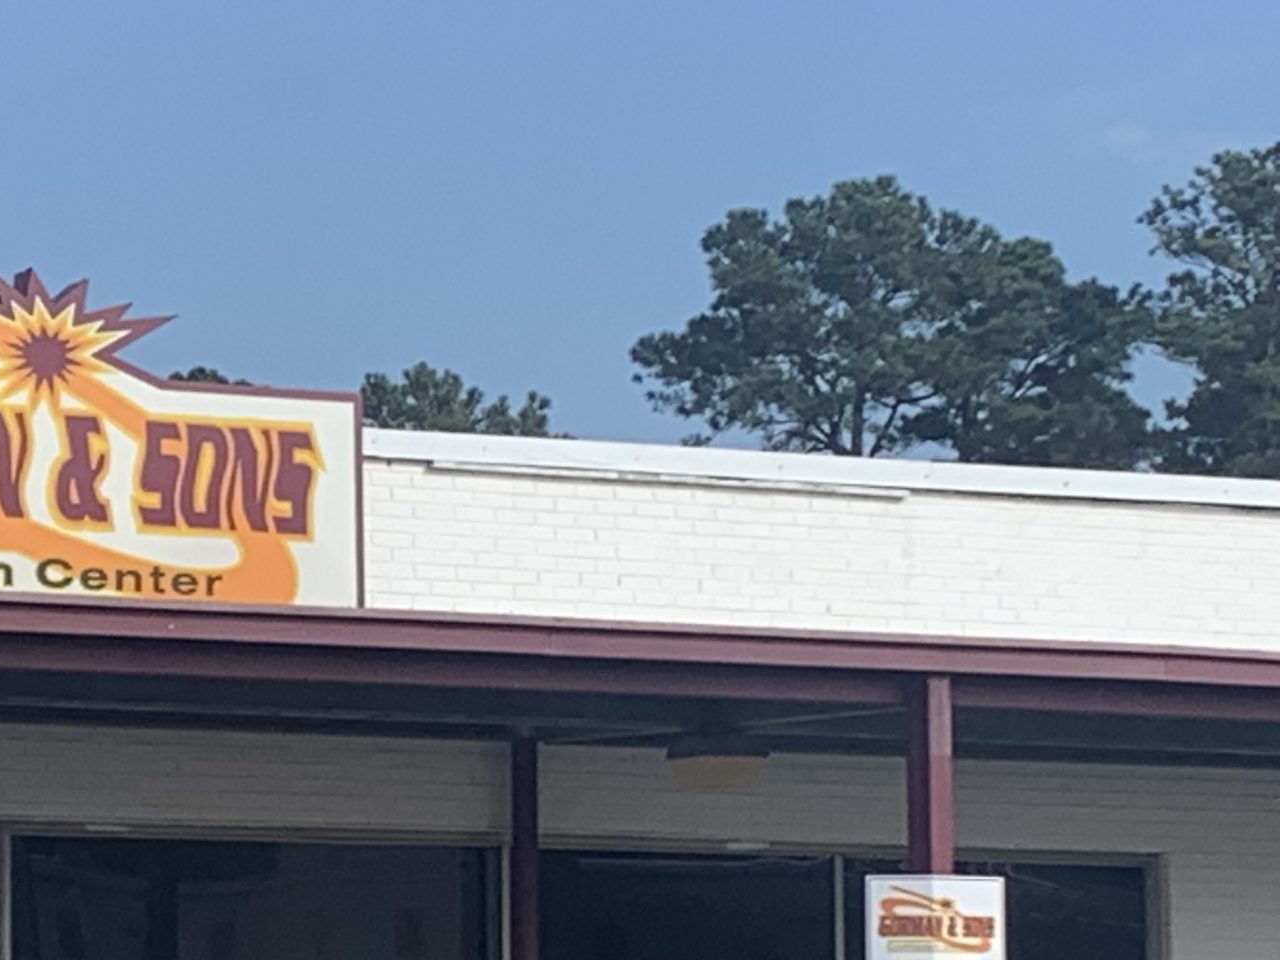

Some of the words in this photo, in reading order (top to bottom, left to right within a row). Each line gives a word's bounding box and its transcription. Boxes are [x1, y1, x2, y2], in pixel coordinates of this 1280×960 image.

[55, 411, 114, 526] &
[136, 419, 322, 538] SONS
[35, 557, 224, 597] Center
